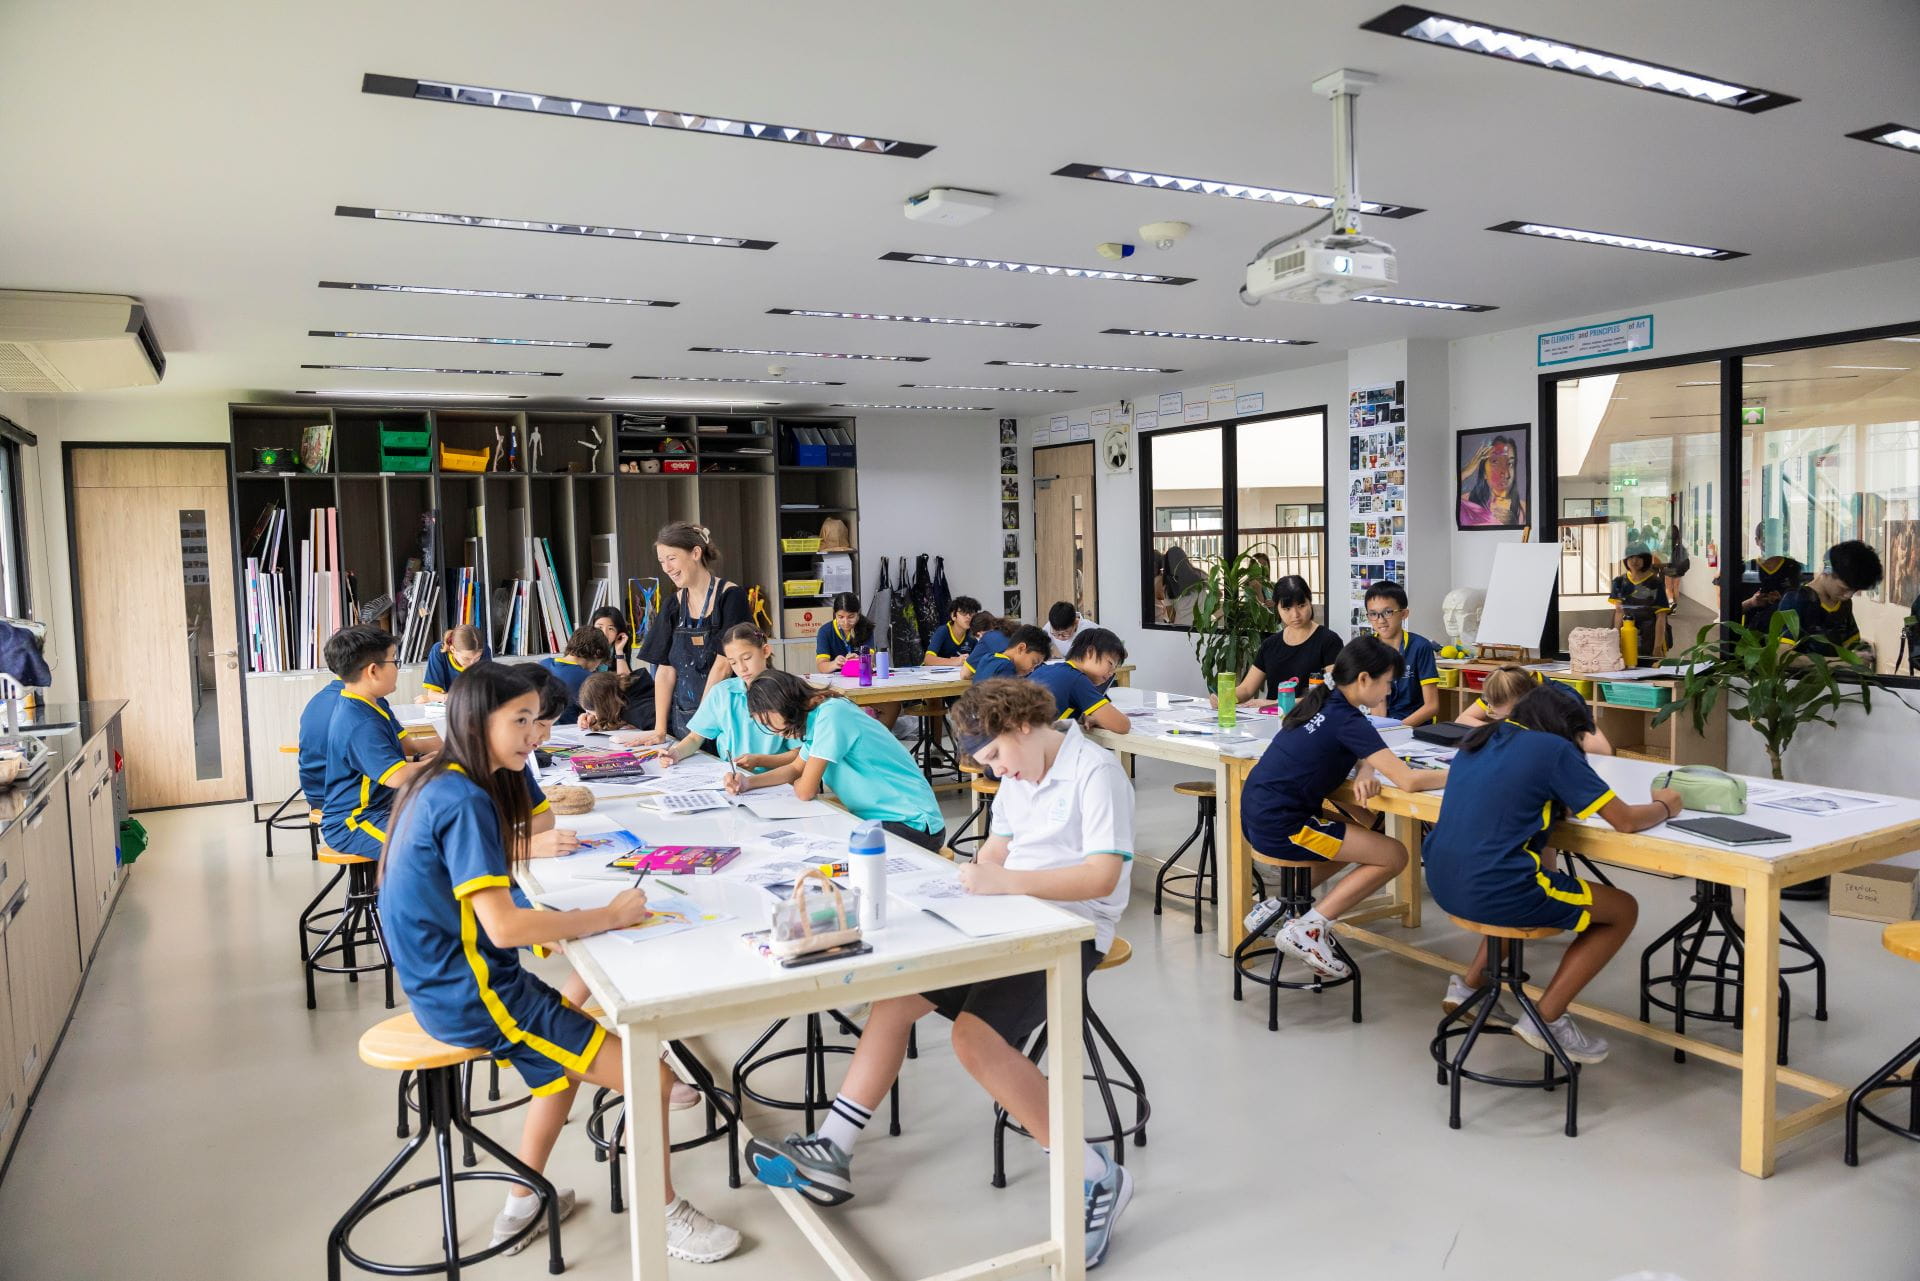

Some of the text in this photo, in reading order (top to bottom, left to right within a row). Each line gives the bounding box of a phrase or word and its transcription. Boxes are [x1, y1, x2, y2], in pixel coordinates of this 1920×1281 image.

[1541, 338, 1550, 346] The
[1551, 334, 1575, 344] ELEMENTS
[1578, 331, 1589, 339] and
[1589, 325, 1621, 337] PRINCIPLES
[1635, 320, 1646, 329] Art
